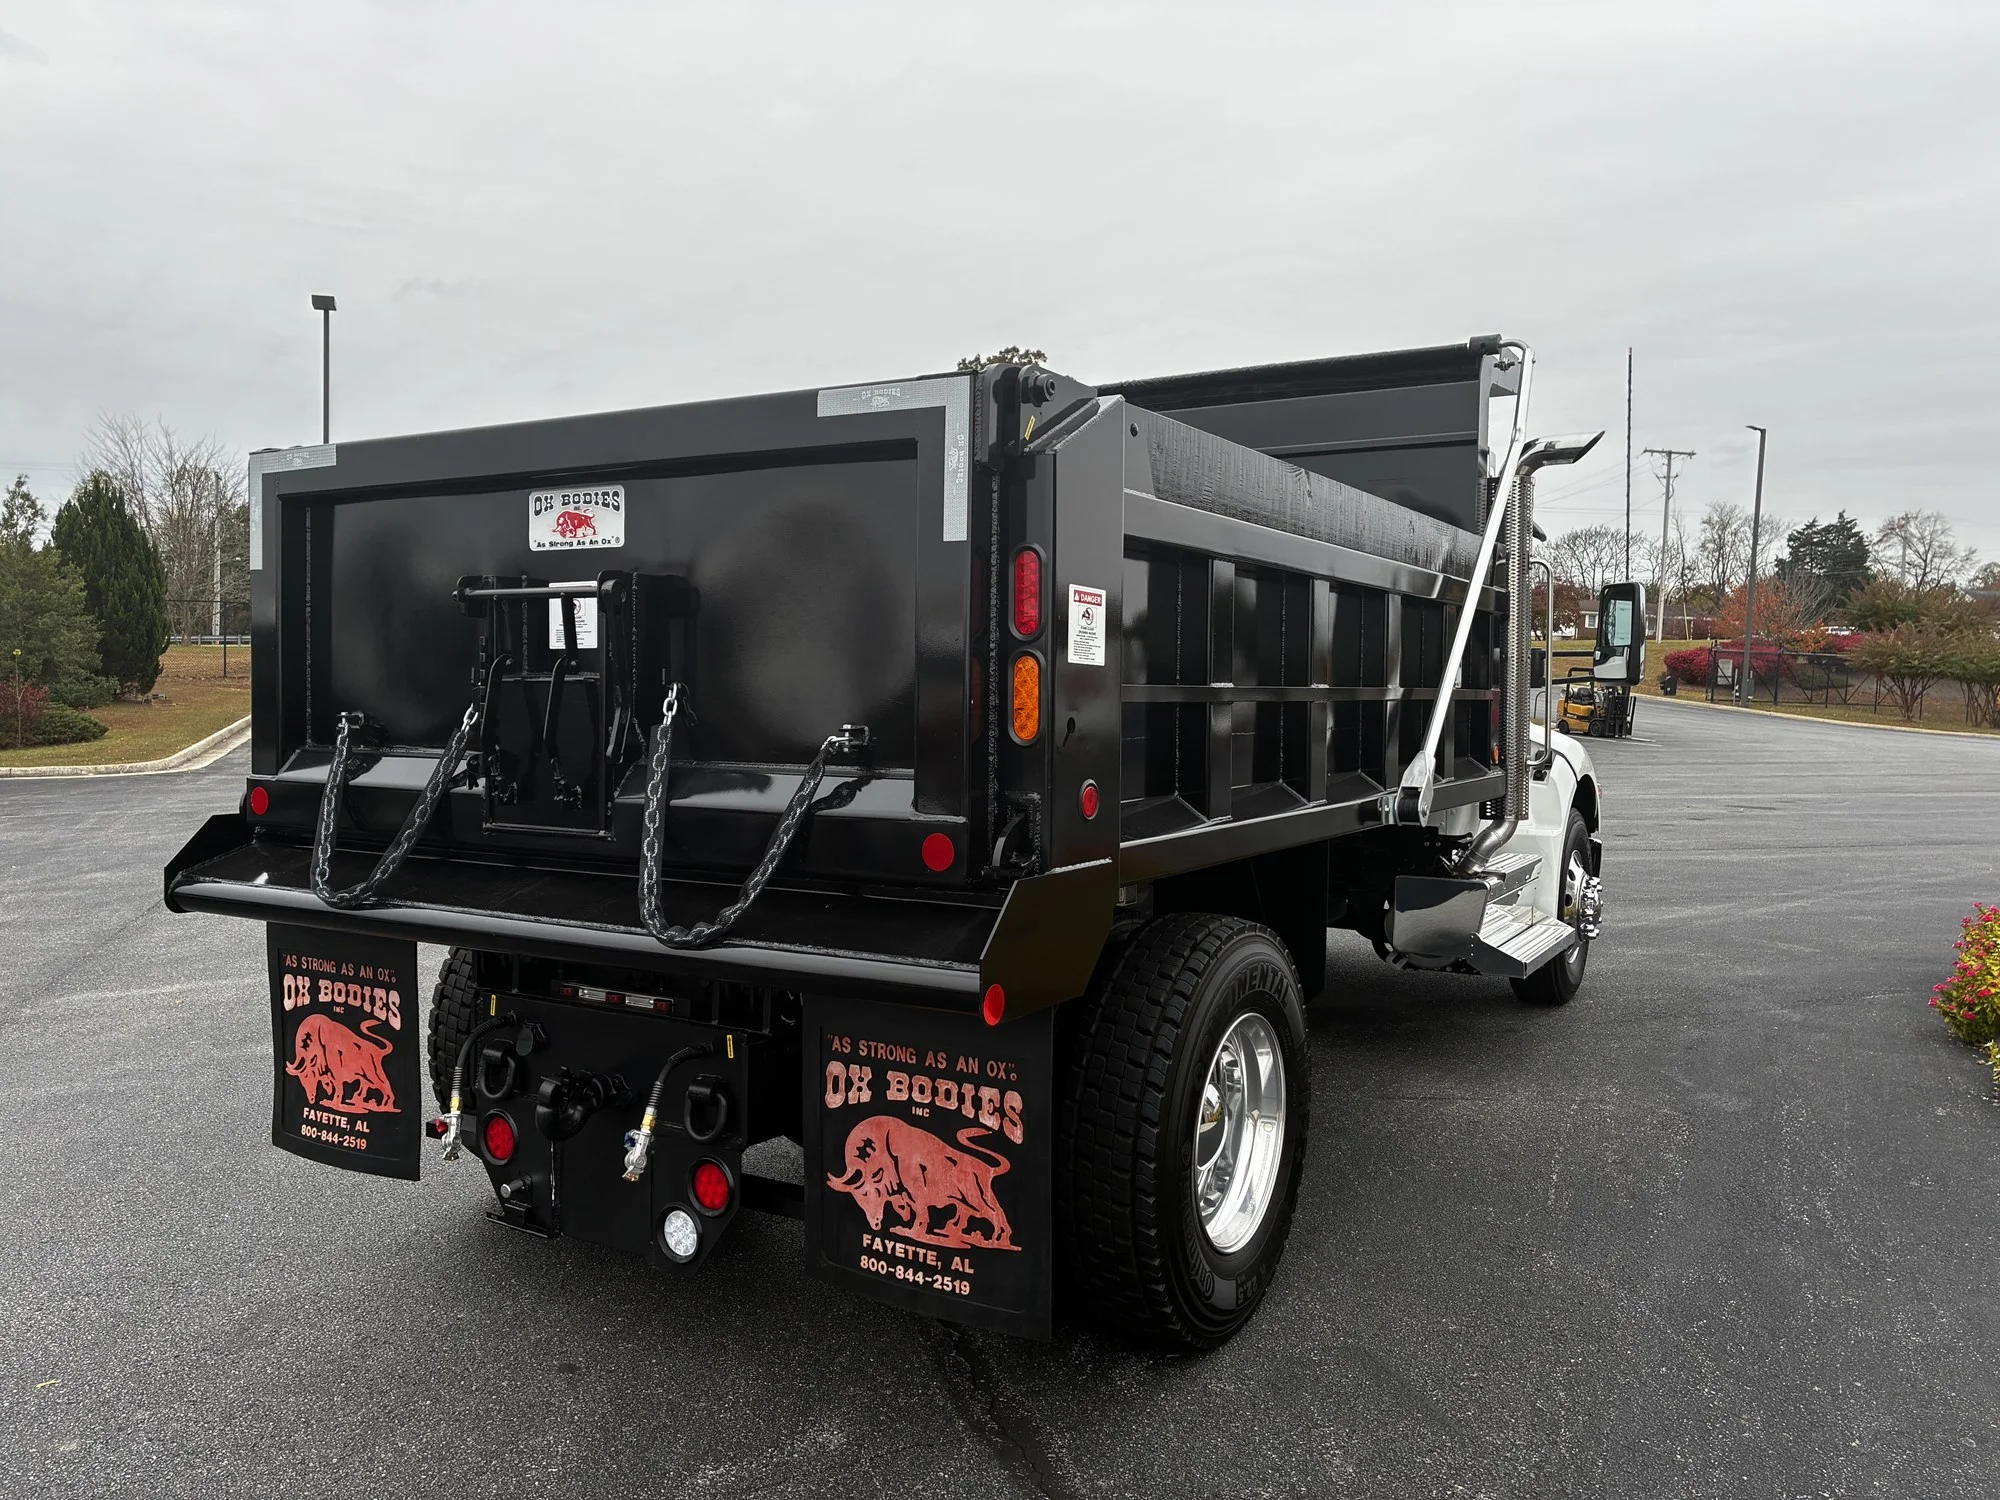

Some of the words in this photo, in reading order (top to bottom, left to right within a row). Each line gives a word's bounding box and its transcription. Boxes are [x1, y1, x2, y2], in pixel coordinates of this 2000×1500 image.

[533, 495, 554, 517] OX
[561, 490, 620, 512] BODIES
[1080, 593, 1102, 604] DANGER
[301, 956, 336, 974] STRONG
[341, 962, 354, 977] AS
[360, 965, 373, 979] AN
[283, 973, 311, 1011] OX
[318, 978, 401, 1031] BODIES
[333, 1005, 345, 1014] INC
[858, 1039, 917, 1065] STRONG
[925, 1050, 948, 1069] AS
[956, 1055, 979, 1075] AN
[825, 1060, 873, 1109] OX
[886, 1070, 1024, 1145] BODIES
[911, 1106, 930, 1118] INC
[303, 1107, 351, 1131] FAYETTE,
[355, 1120, 370, 1133] AL
[301, 1124, 367, 1150] 800-844-2519
[862, 1233, 941, 1270] FAYETTE,
[951, 1256, 975, 1274] AL
[860, 1255, 971, 1295] 800-844-2519
